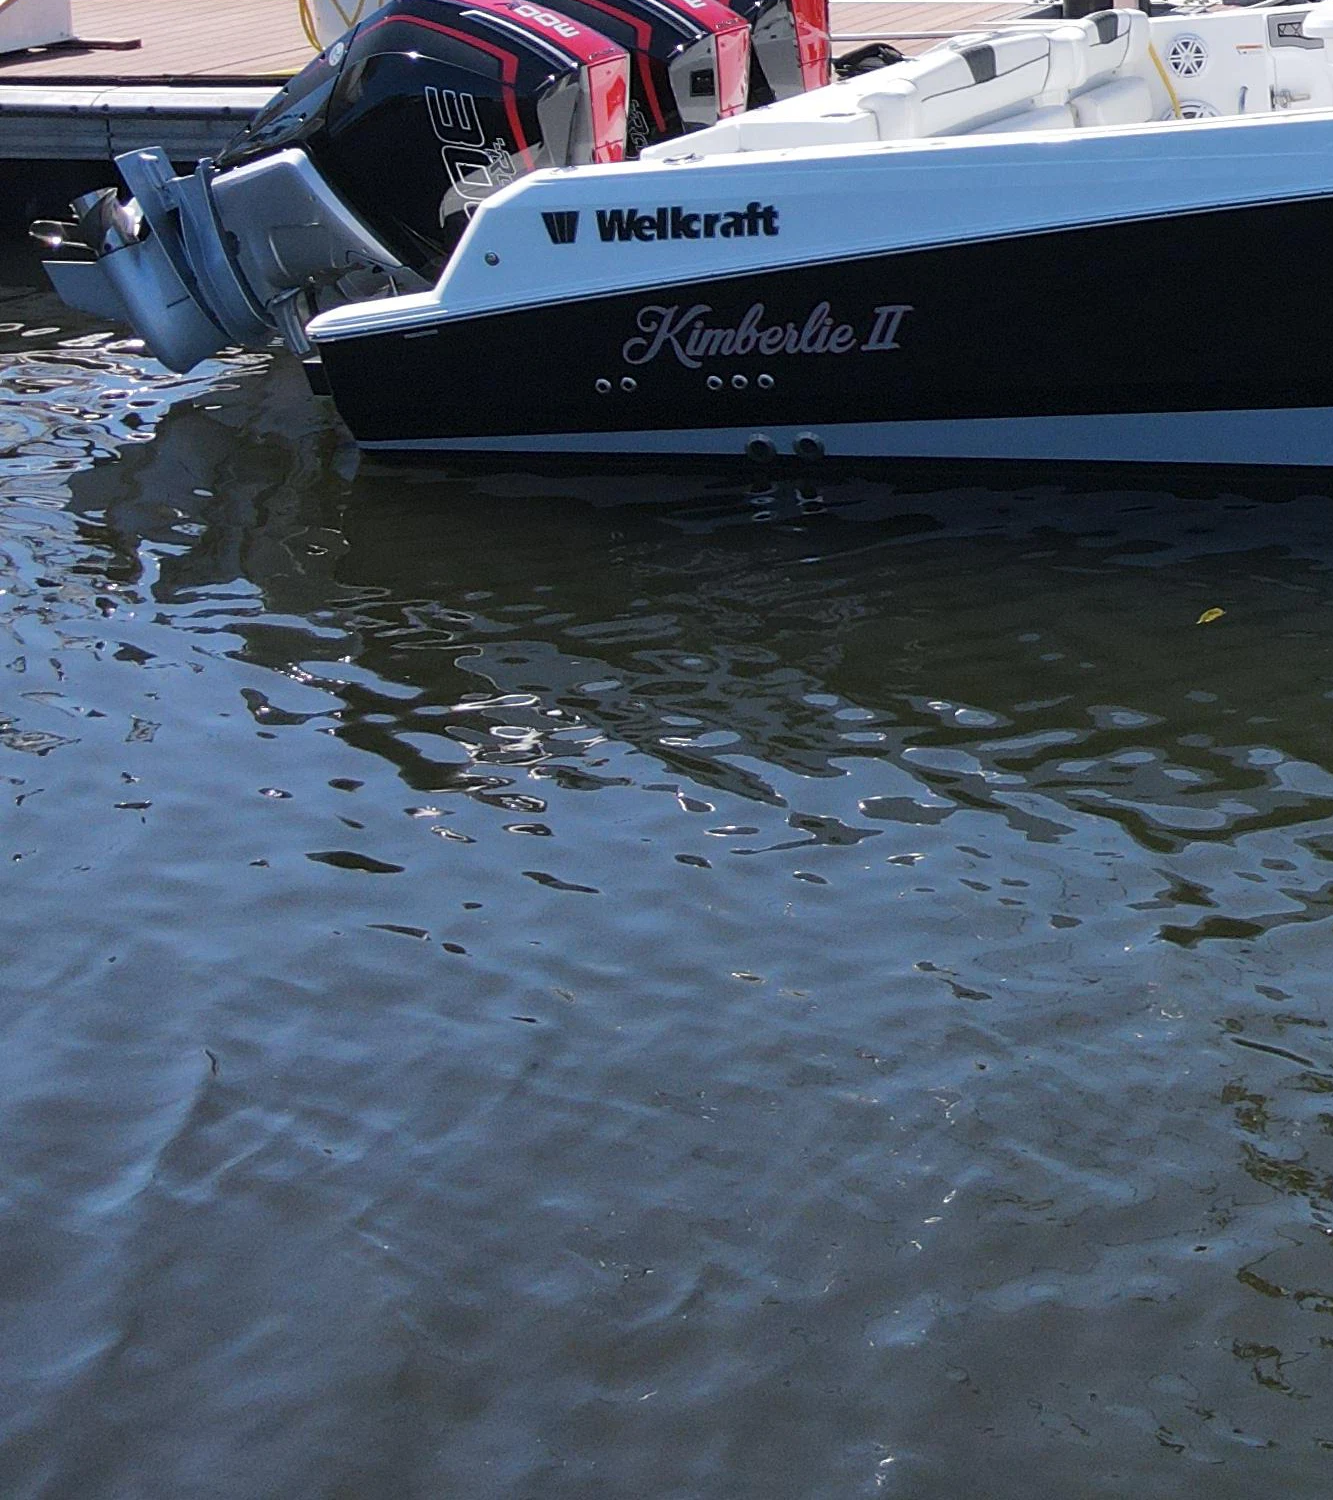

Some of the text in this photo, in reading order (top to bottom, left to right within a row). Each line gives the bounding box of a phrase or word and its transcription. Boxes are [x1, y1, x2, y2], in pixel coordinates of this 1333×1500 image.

[424, 85, 494, 220] 30
[596, 201, 779, 242] Wellcraft
[621, 300, 858, 369] Kimberlie
